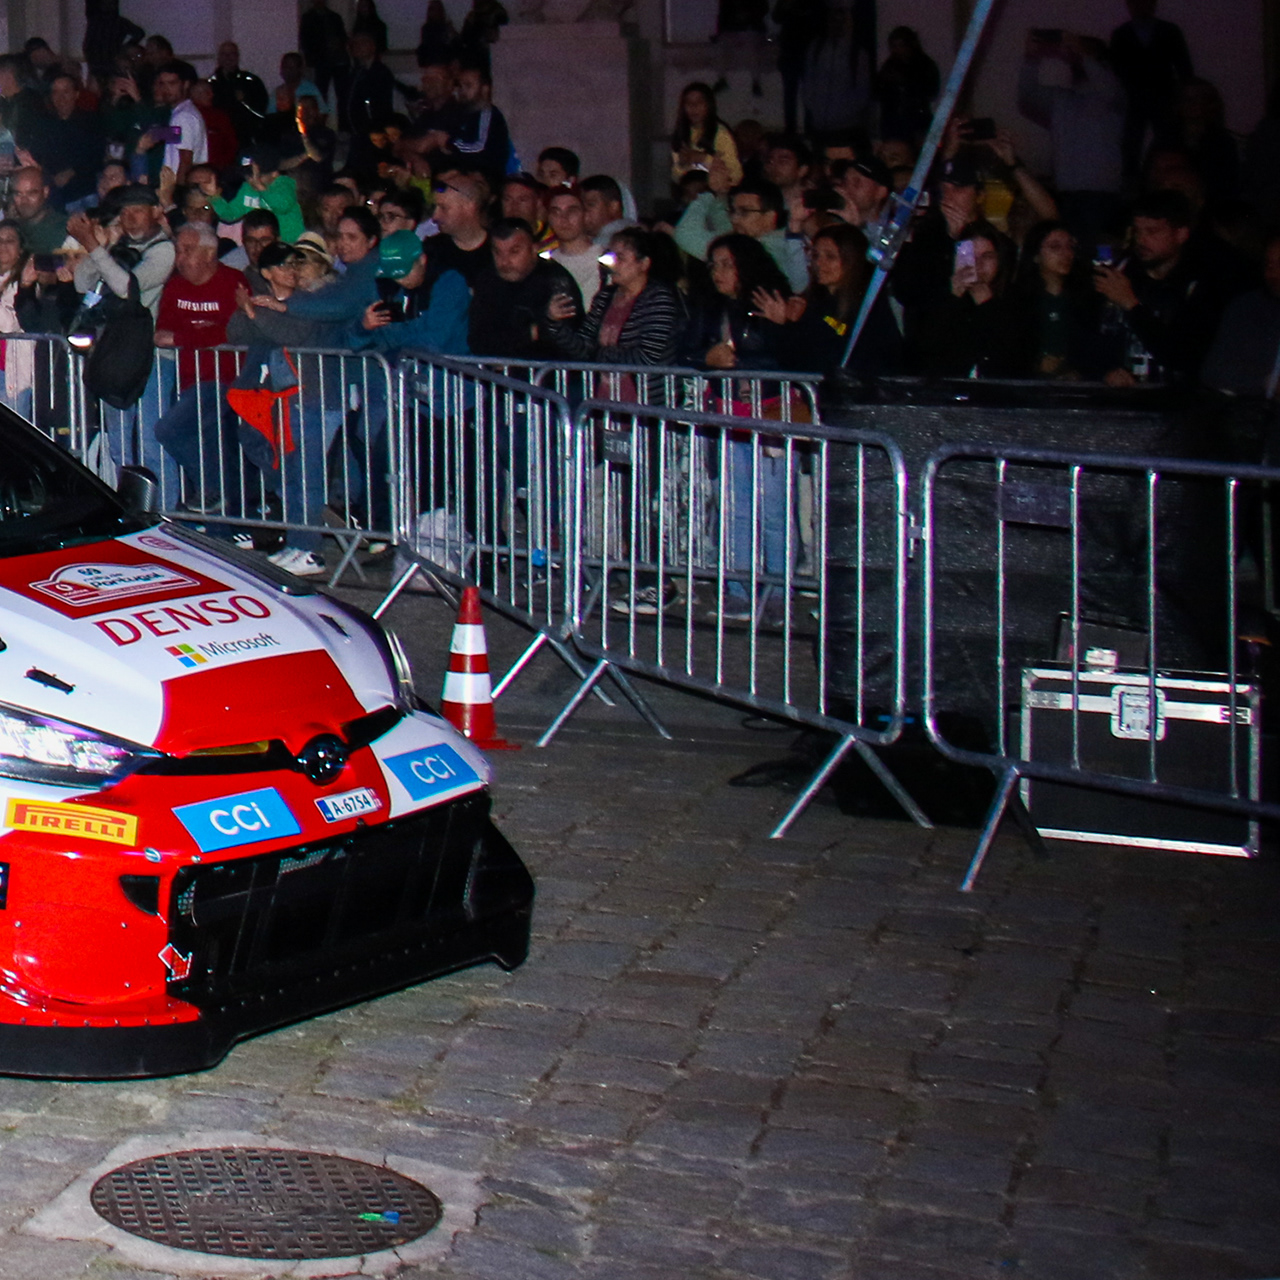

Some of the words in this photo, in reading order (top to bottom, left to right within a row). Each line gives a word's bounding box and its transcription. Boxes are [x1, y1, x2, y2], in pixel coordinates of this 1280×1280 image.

[89, 571, 165, 589] Portugal
[91, 595, 272, 648] DENSO
[198, 632, 281, 658] Microsoft
[330, 793, 373, 816] A-6754
[13, 803, 128, 839] PIRELLI
